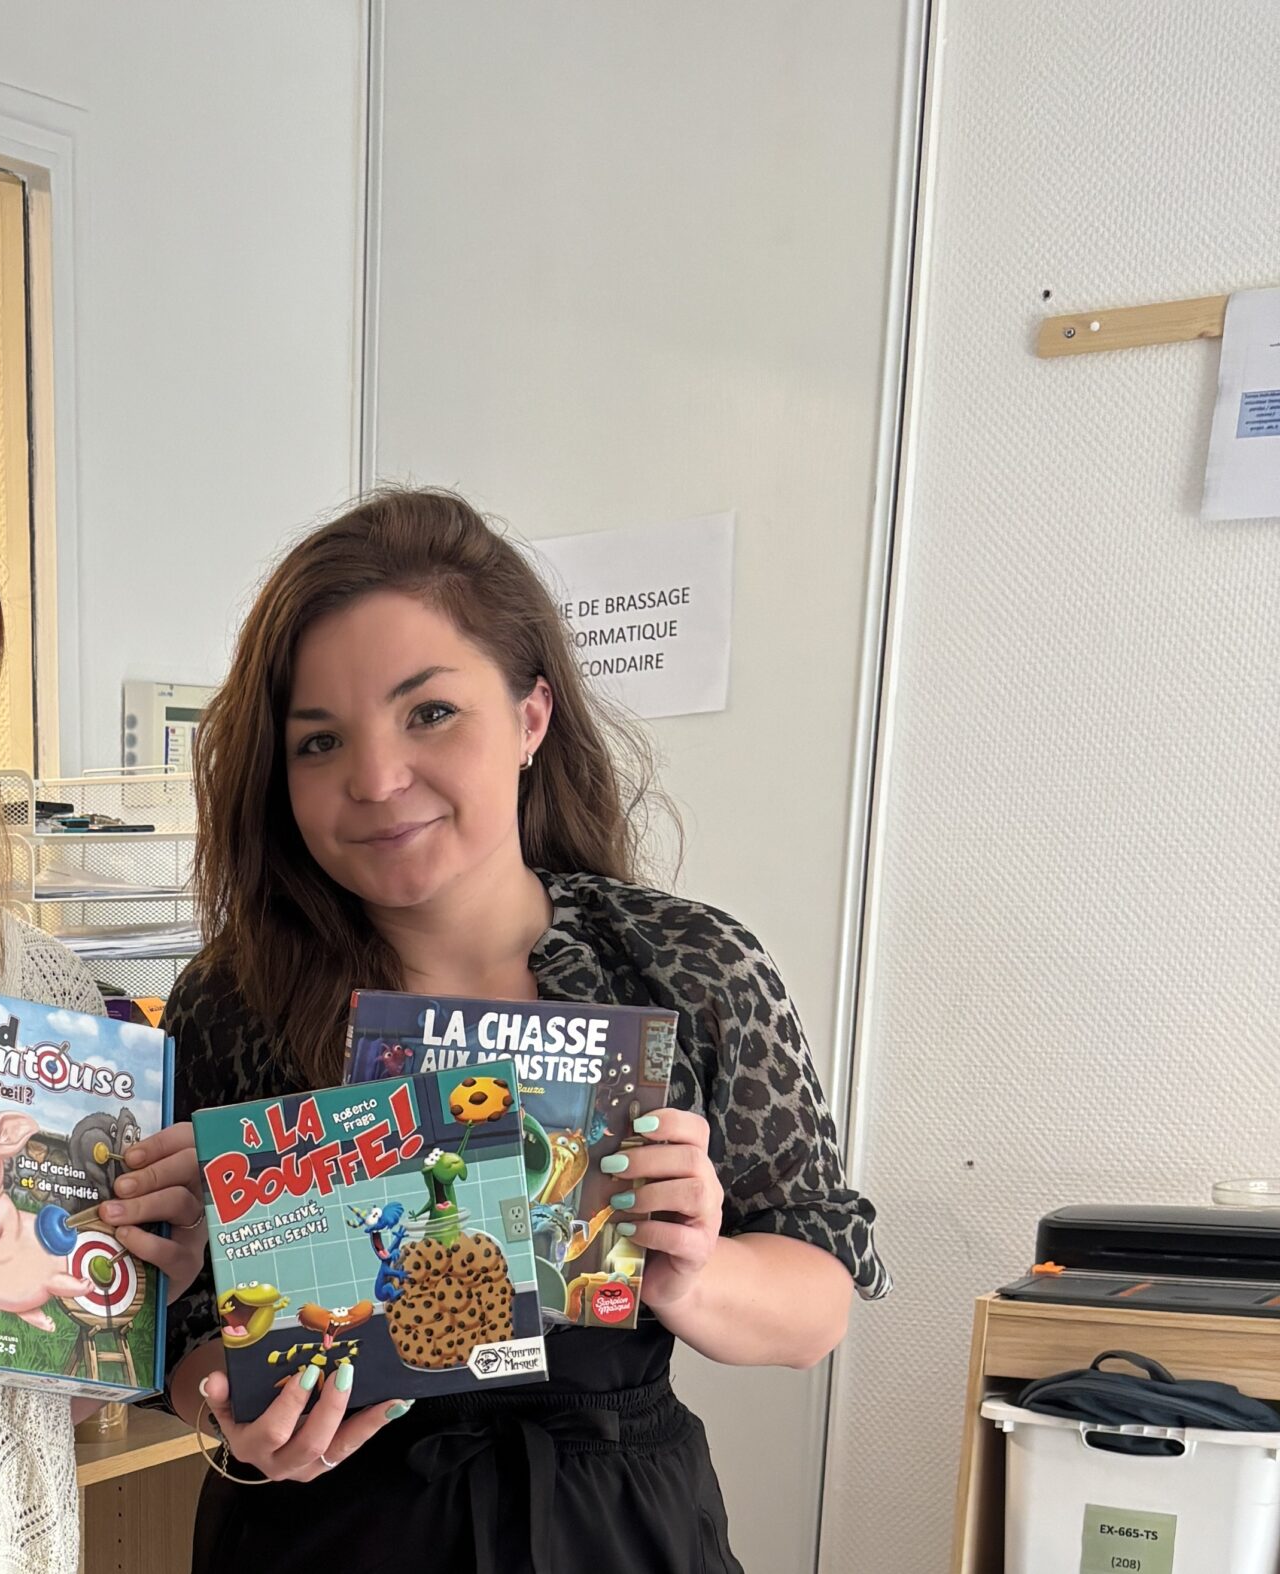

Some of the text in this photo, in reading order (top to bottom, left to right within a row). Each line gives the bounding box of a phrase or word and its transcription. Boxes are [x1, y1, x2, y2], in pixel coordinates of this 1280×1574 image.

[578, 599, 599, 618] DE
[605, 586, 691, 614] BRASSAGE
[574, 620, 678, 648] ORMATIQUE
[580, 652, 665, 678] CONDAIRE
[422, 1009, 609, 1056] LA CHASSE
[420, 1049, 603, 1084] AUX NSTRES
[239, 1096, 326, 1154] À LA
[343, 1112, 376, 1132] Fraga
[18, 1156, 86, 1179] Jeu d'action
[21, 1177, 99, 1200] et de rapidité
[1099, 1523, 1158, 1541] EX-665-TS
[1111, 1556, 1141, 1572] (208)
